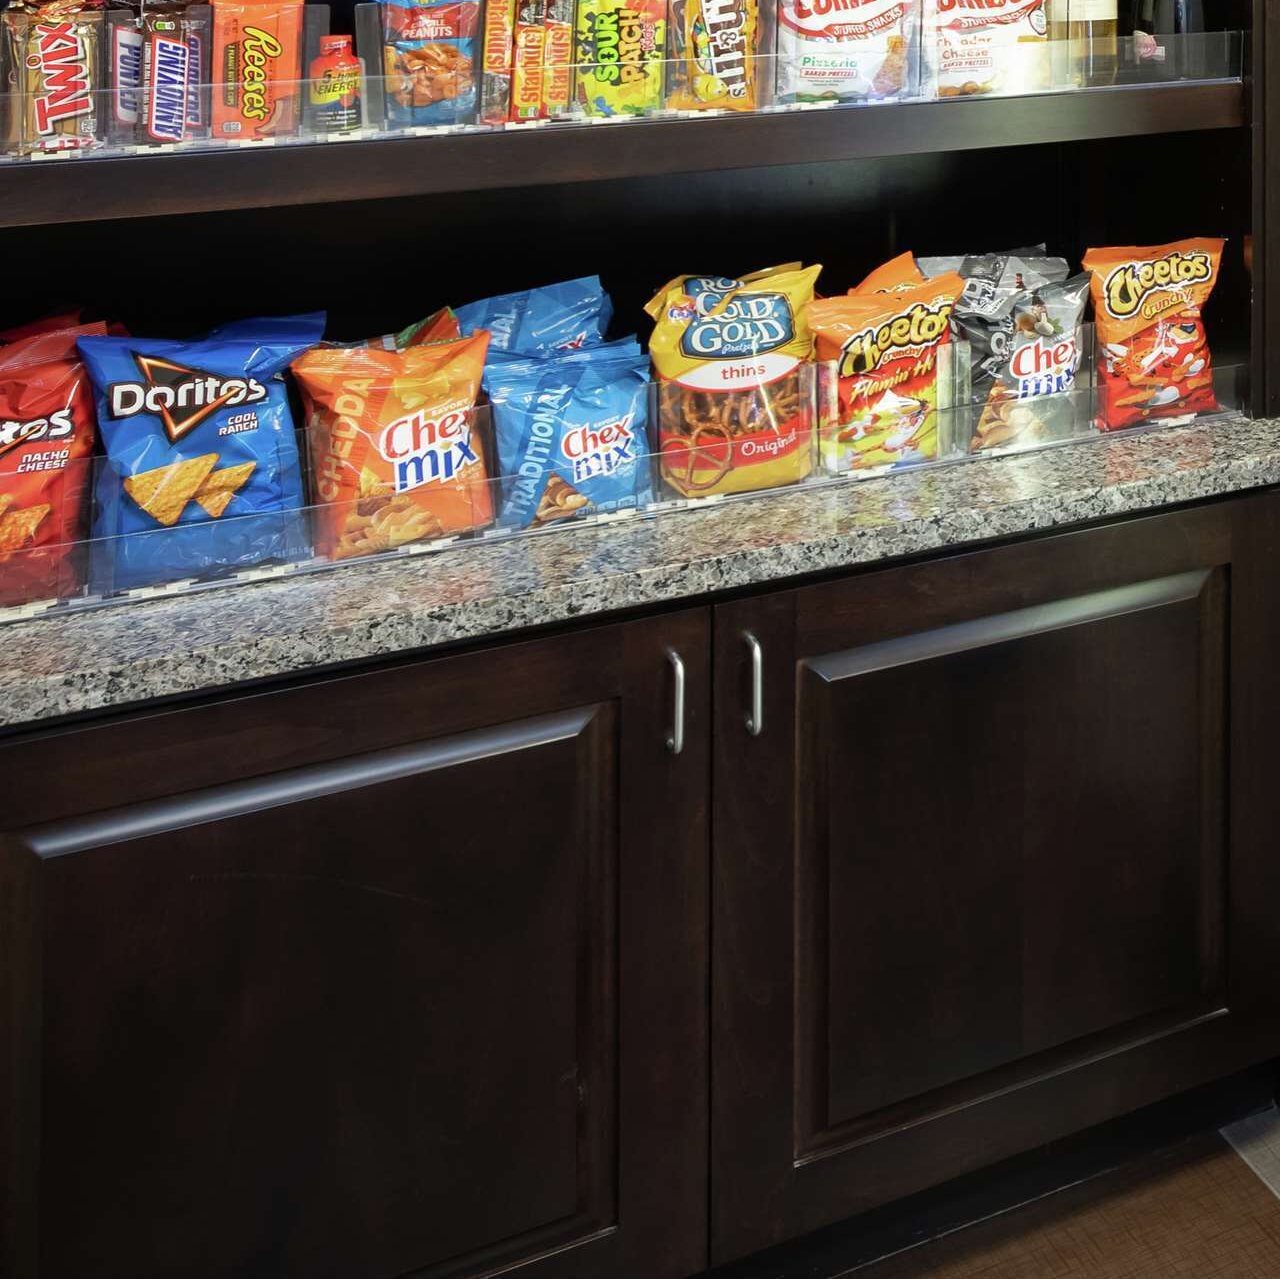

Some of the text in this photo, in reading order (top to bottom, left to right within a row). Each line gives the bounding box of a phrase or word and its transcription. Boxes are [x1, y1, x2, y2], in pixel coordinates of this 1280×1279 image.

[402, 26, 453, 39] PEANUTS
[867, 7, 903, 32] SNACKS
[596, 13, 619, 82] SOUR
[619, 8, 645, 84] PATCH
[241, 26, 282, 121] Reese's
[1106, 252, 1211, 315] Cheetos
[1142, 288, 1193, 319] Crunchy
[692, 320, 785, 353] GOLD
[721, 364, 765, 381] thins
[113, 376, 266, 418] Doritos
[218, 421, 258, 436] RANCH
[227, 412, 257, 426] COOL
[563, 419, 631, 458] Chex
[741, 432, 797, 457] Original
[22, 451, 69, 464] NACHO
